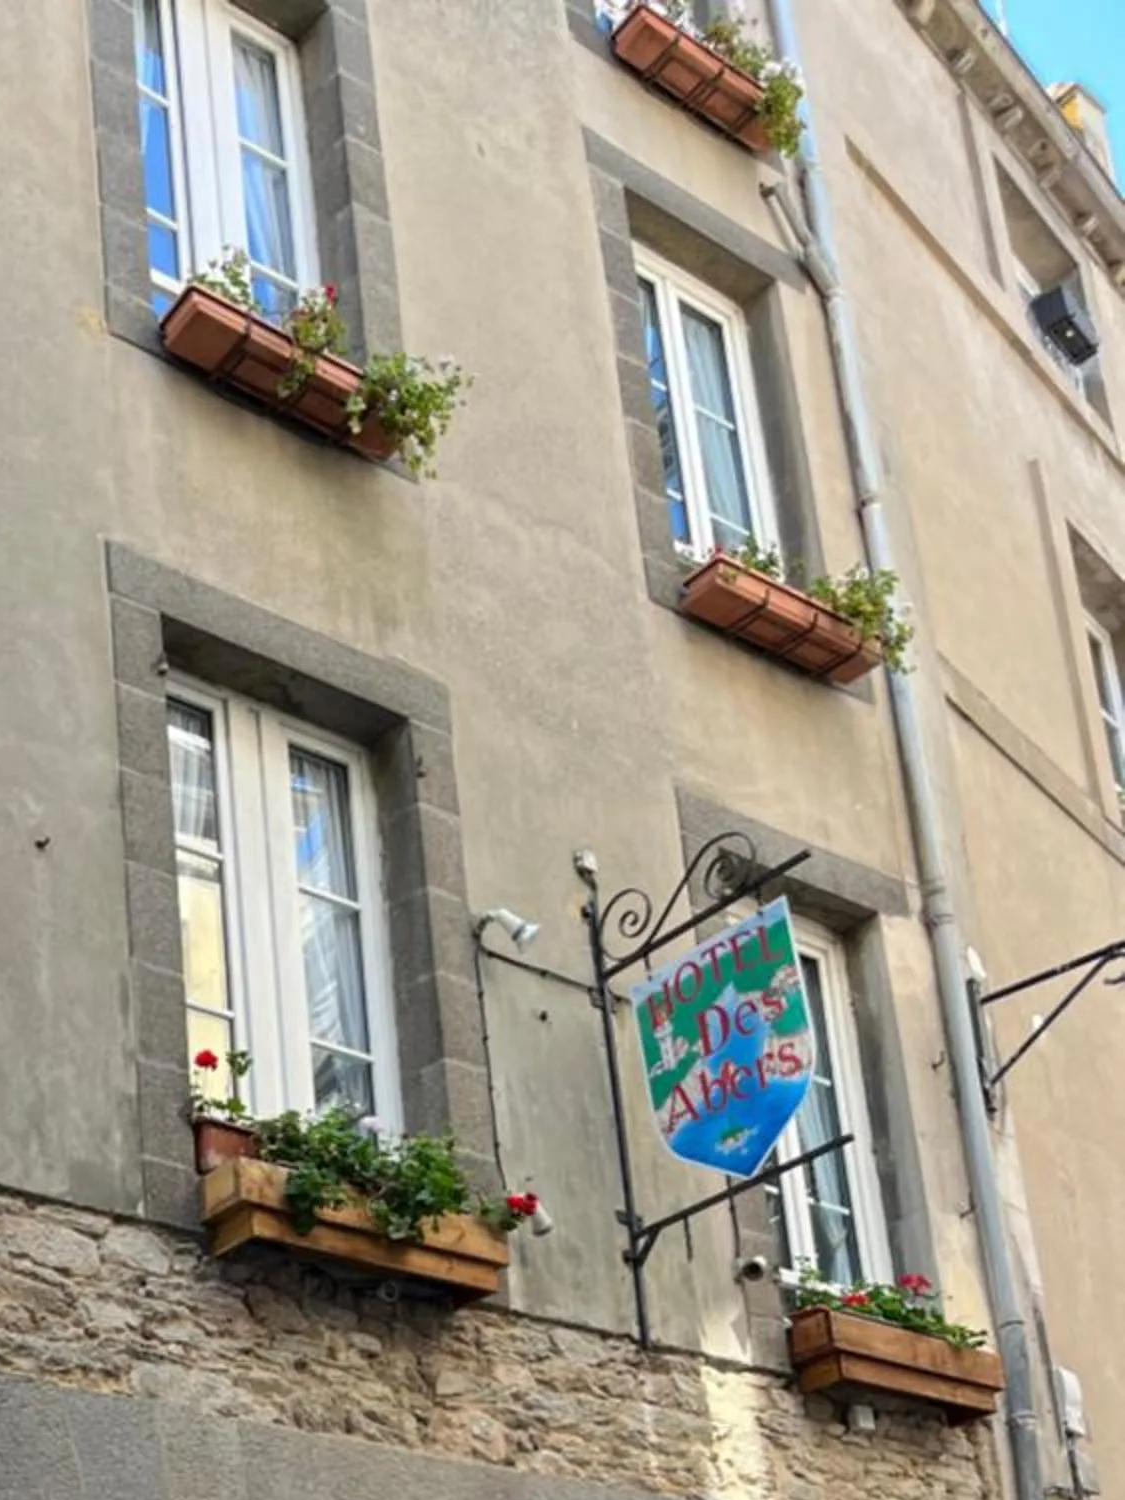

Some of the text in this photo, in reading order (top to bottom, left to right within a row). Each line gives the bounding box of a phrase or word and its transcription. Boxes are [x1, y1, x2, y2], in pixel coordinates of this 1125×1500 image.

[646, 926, 783, 1030] HOTEL
[695, 991, 785, 1057] Des
[665, 1042, 803, 1135] Abers
